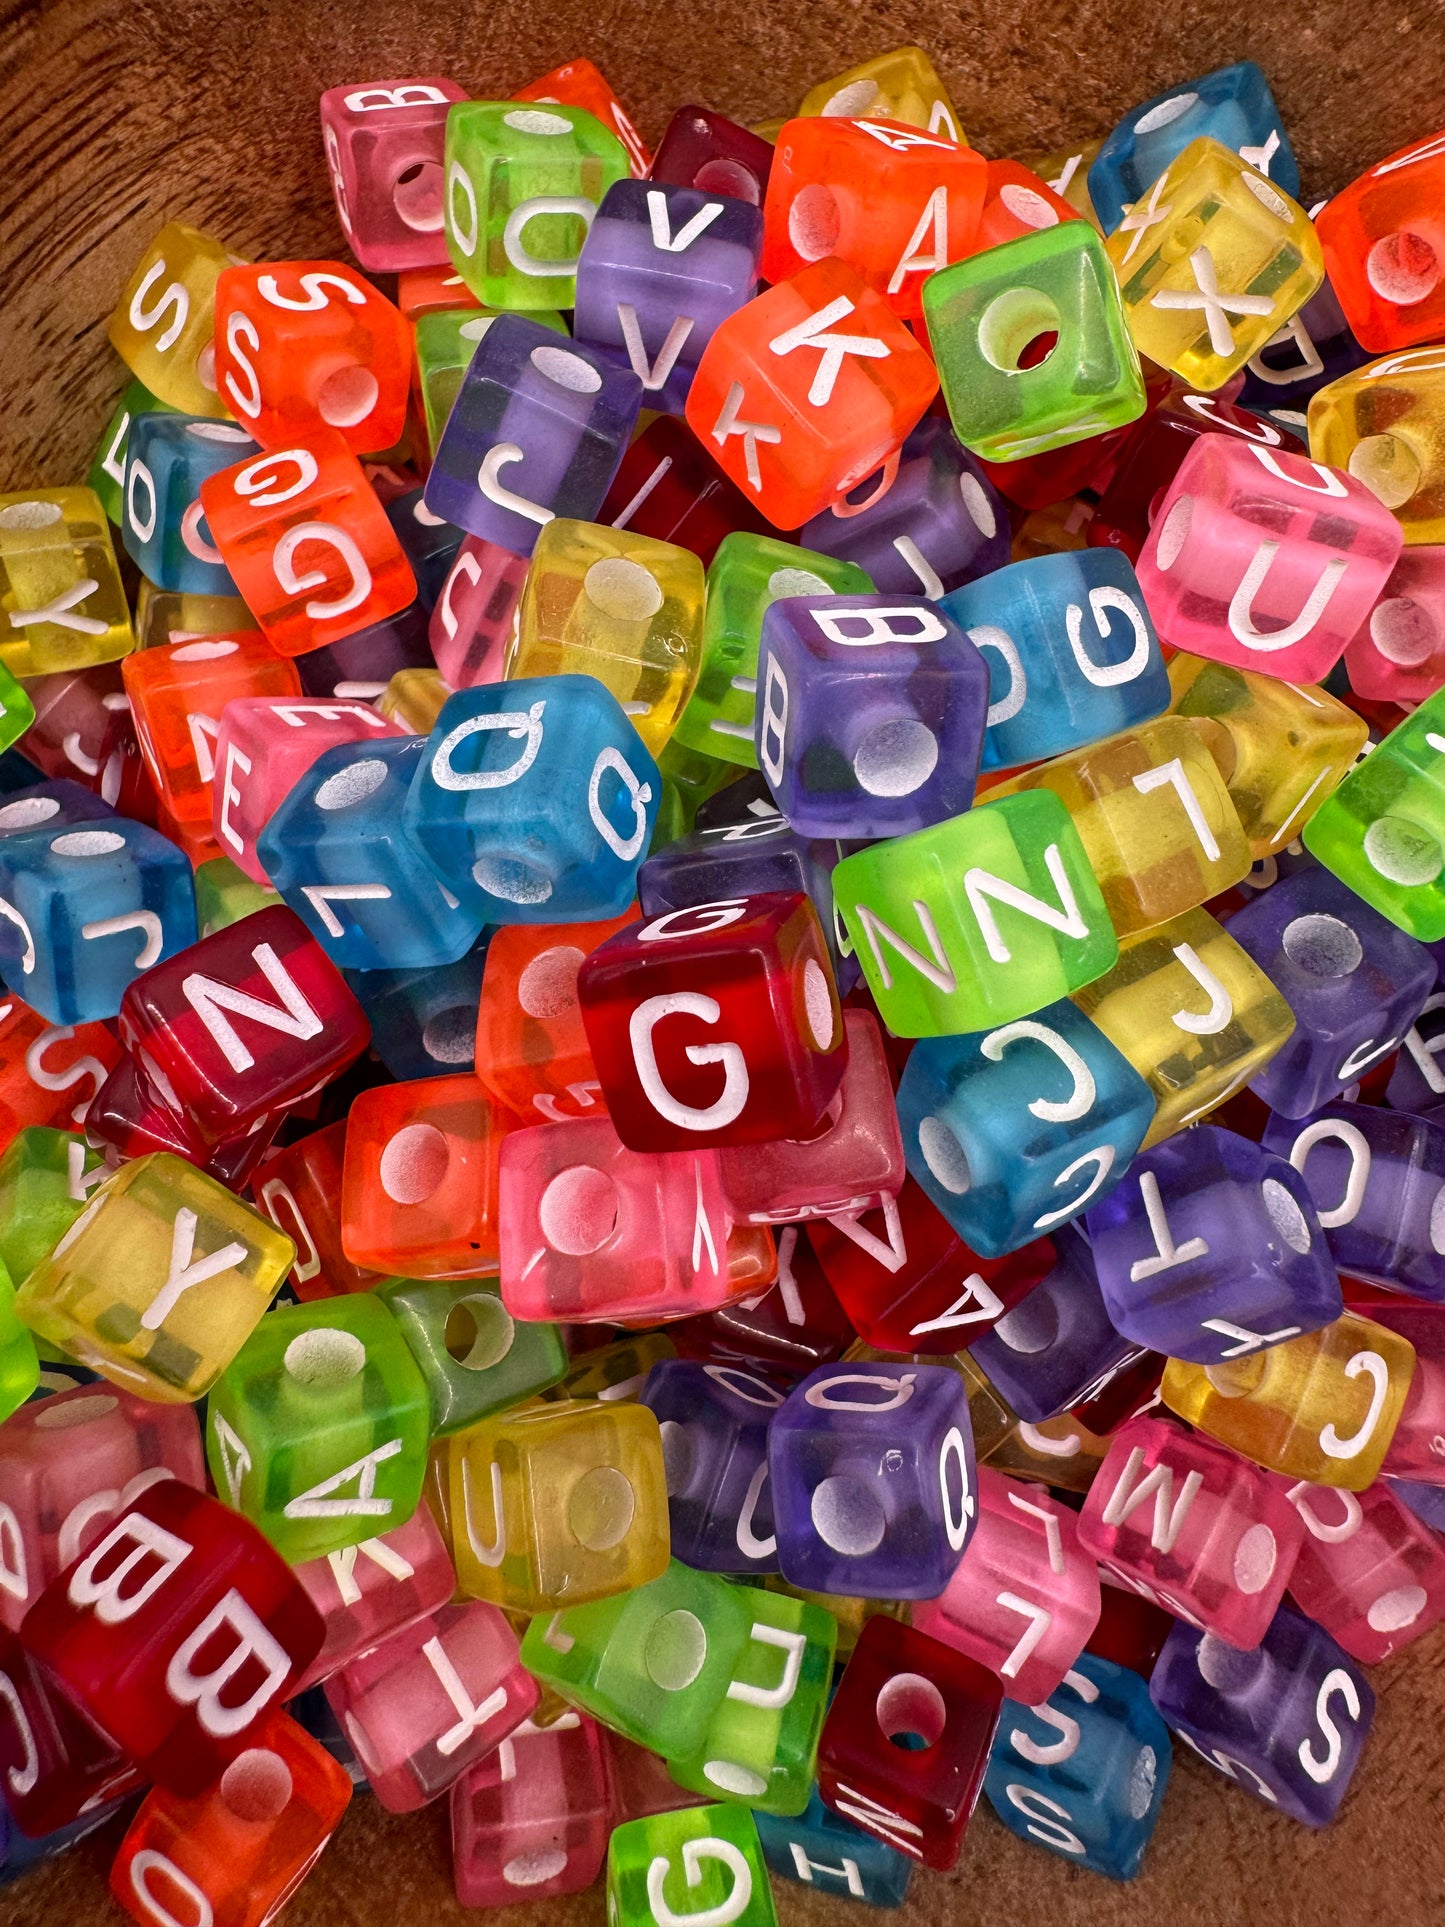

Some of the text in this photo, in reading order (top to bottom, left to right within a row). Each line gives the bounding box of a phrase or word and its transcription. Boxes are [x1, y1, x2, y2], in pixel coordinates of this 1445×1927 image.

[344, 85, 453, 111] B
[647, 190, 725, 252] V
[887, 185, 948, 294] A
[1120, 172, 1173, 266] X
[130, 258, 189, 353] S
[257, 273, 368, 312] S
[1150, 245, 1277, 358] X
[225, 311, 261, 419] S
[617, 302, 694, 391] V
[769, 295, 892, 406] K
[234, 449, 319, 507] G
[478, 442, 557, 526] J
[712, 380, 782, 493] K
[9, 578, 109, 635] Y
[273, 521, 372, 620] G
[1228, 538, 1349, 653] U
[809, 607, 948, 646] B
[1066, 586, 1149, 688] G
[270, 705, 387, 727] E
[432, 700, 547, 792] Q
[761, 650, 788, 789] B
[221, 741, 252, 855] E
[588, 746, 653, 862] Q
[1133, 757, 1221, 862] L
[82, 910, 164, 970] J
[637, 899, 750, 942] G
[855, 900, 958, 995] N
[964, 843, 1090, 964] N
[182, 942, 324, 1074] N
[1171, 942, 1234, 1036] J
[629, 992, 750, 1132] G
[980, 1020, 1097, 1123] C
[1033, 1144, 1116, 1228] C
[1131, 1171, 1210, 1284] T
[141, 1207, 249, 1331] Y
[909, 1273, 1005, 1336] A
[805, 1373, 918, 1412] Q
[1319, 1351, 1390, 1460] C
[214, 1410, 252, 1513] A
[284, 1439, 403, 1520] A
[940, 1426, 975, 1553] Q
[462, 1457, 507, 1568] U
[1008, 1492, 1066, 1576] L
[67, 1512, 194, 1626] B
[166, 1588, 293, 1739] B
[995, 1591, 1053, 1679] L
[422, 1636, 508, 1756] T
[1010, 1669, 1100, 1766] S
[1298, 1668, 1361, 1785] S
[1007, 1783, 1088, 1854] S
[646, 1837, 753, 1927] G
[789, 1842, 865, 1897] H
